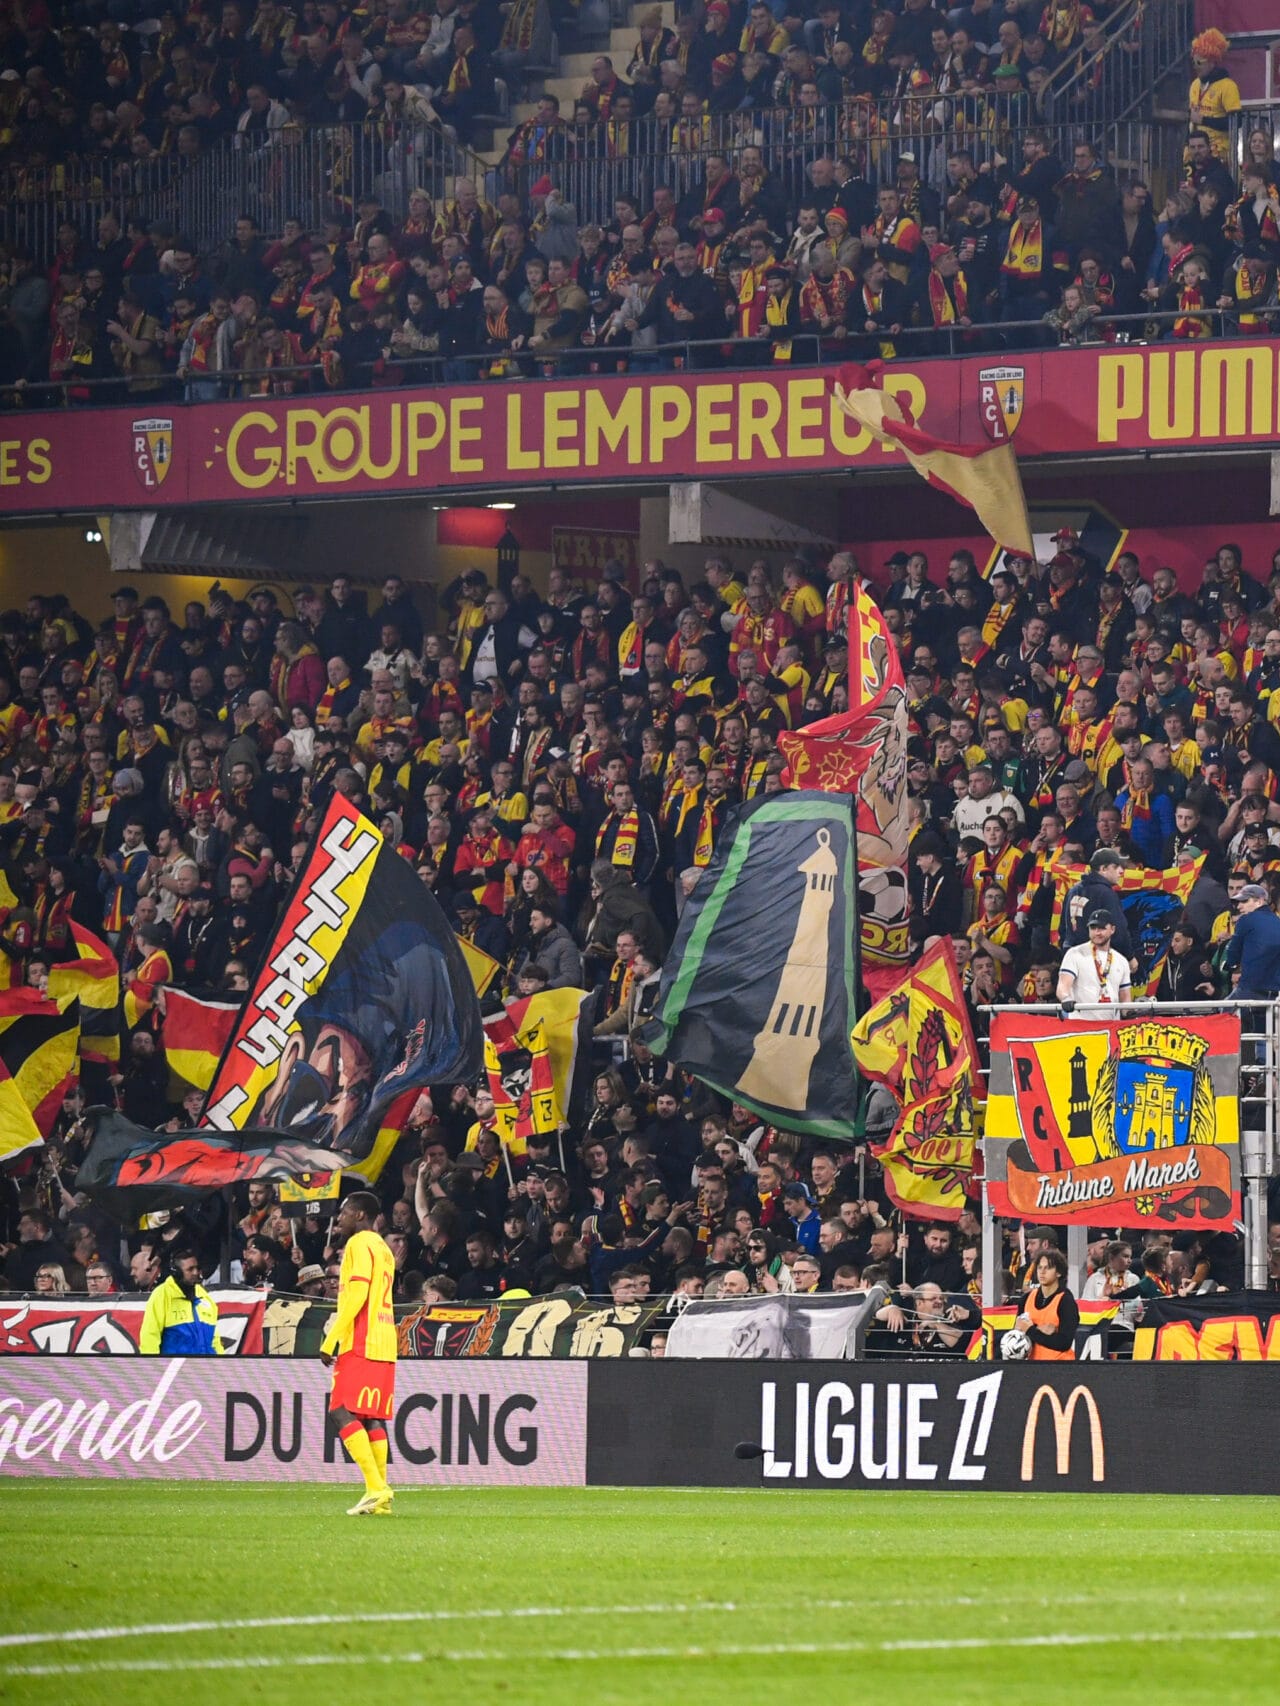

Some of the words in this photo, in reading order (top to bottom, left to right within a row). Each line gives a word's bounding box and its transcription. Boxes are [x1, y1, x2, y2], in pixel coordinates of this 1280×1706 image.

[225, 396, 484, 490] GROUPE
[982, 386, 1004, 438] RCL
[135, 437, 155, 486] RCL
[237, 816, 379, 1068] ULTRAS
[1034, 1169, 1115, 1209] Tribune
[1123, 1146, 1201, 1195] Marek
[225, 1391, 303, 1464] DU
[324, 1392, 539, 1466] RCING
[763, 1382, 938, 1480] LIGUE
